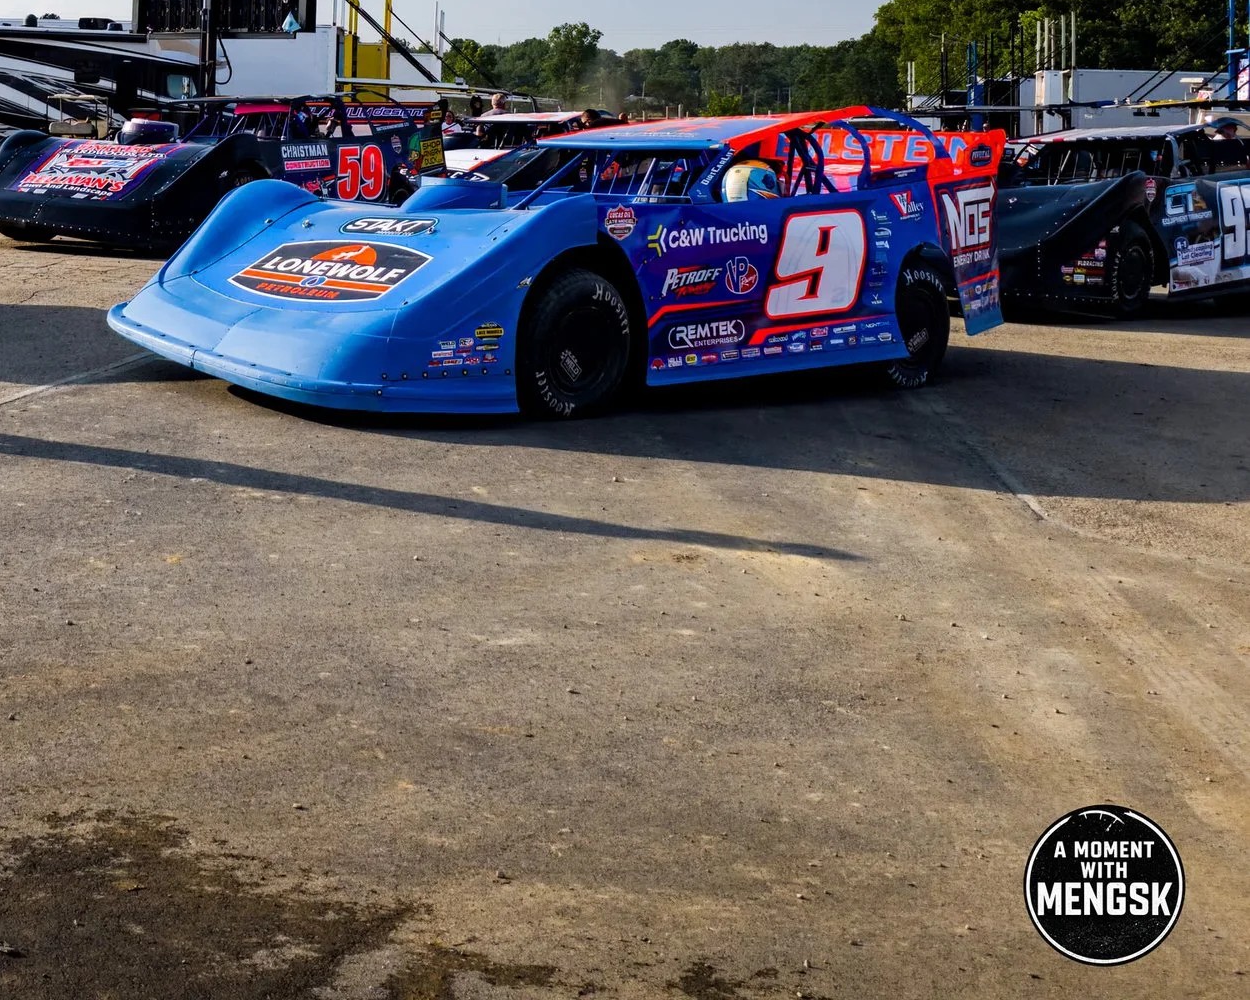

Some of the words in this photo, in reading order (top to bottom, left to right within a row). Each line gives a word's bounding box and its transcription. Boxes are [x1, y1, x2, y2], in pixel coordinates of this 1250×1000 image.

[281, 144, 328, 158] CHRISTMAN
[422, 140, 441, 150] SHOP
[775, 131, 968, 164] BLSTEN
[337, 144, 384, 201] 59
[63, 185, 114, 197] Landscape
[941, 181, 995, 250] NOS
[668, 227, 704, 248] C&W
[707, 221, 768, 244] Trucking
[262, 256, 407, 283] LONEWOLF
[765, 209, 866, 320] 9
[256, 282, 340, 299] PETROLEUM
[661, 267, 724, 297] PETROFF
[676, 320, 738, 348] REMTEK
[694, 335, 739, 348] ENTERPRISES
